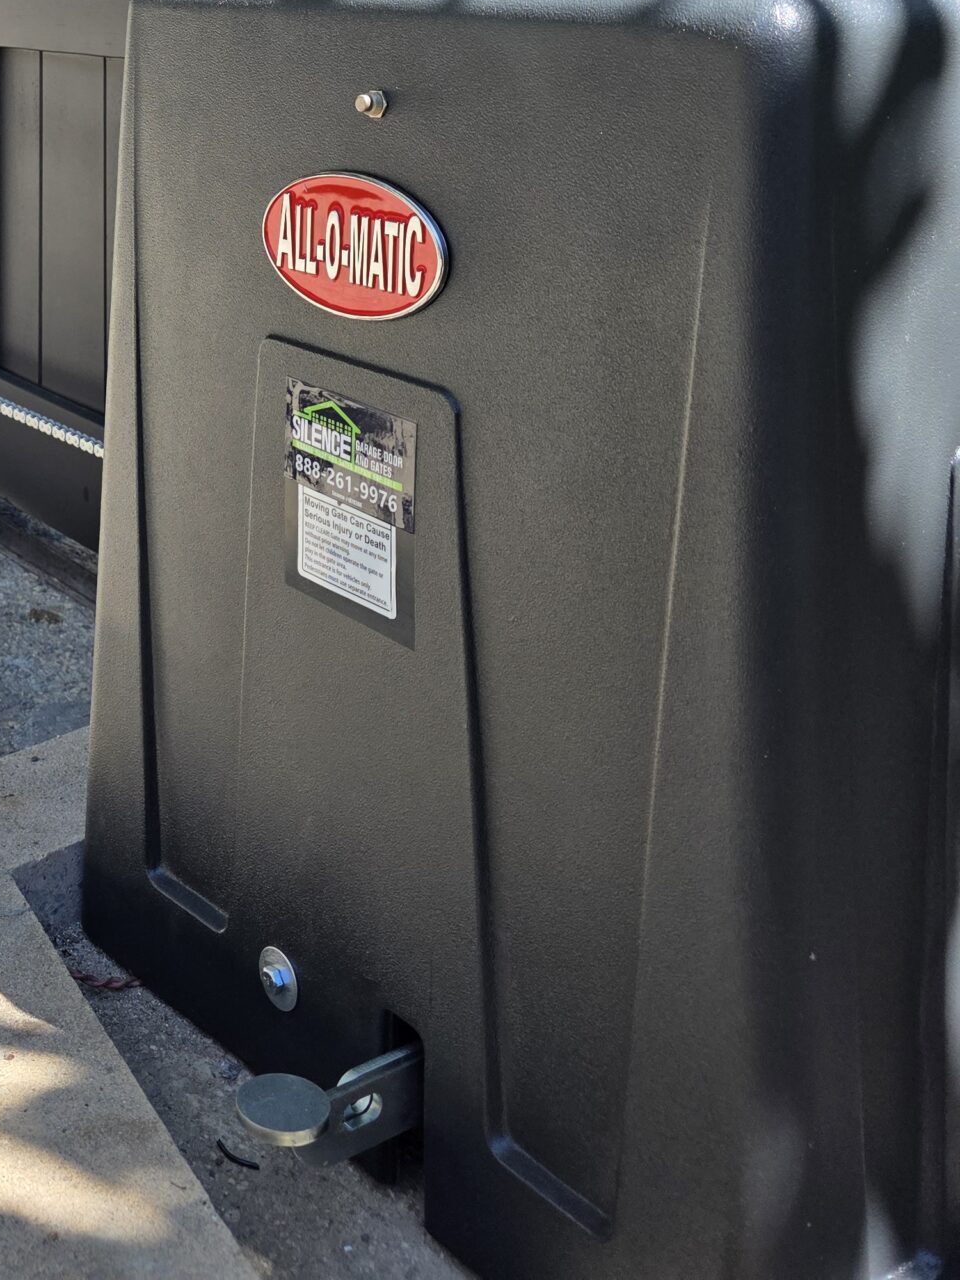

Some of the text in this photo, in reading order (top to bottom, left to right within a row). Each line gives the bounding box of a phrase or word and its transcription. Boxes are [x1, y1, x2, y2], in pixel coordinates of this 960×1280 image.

[276, 192, 424, 297] ALL-O-MATIC
[292, 415, 351, 461] SILENCE
[356, 439, 403, 469] GARAGE DOOR
[356, 454, 392, 478] AND GATES
[295, 453, 397, 513] 888-261-9976
[304, 496, 330, 517] Moving
[331, 508, 348, 522] Gate
[349, 516, 364, 529] Can
[366, 523, 390, 540] Cause
[304, 508, 386, 552] Serious Injury or Death
[304, 531, 321, 541] without
[321, 537, 332, 547] prior
[341, 538, 350, 548] may
[350, 542, 362, 552] move
[369, 550, 377, 560] any
[377, 553, 388, 563] time
[304, 547, 313, 556] play
[326, 556, 336, 566] gate
[304, 554, 313, 563] This
[313, 559, 331, 571] entrance
[343, 573, 360, 585] vehicles
[325, 546, 342, 559] children
[342, 556, 359, 568] operate
[368, 567, 378, 577] gate
[304, 562, 328, 578] Pedestrians
[339, 579, 347, 587] use
[347, 582, 367, 596] separate
